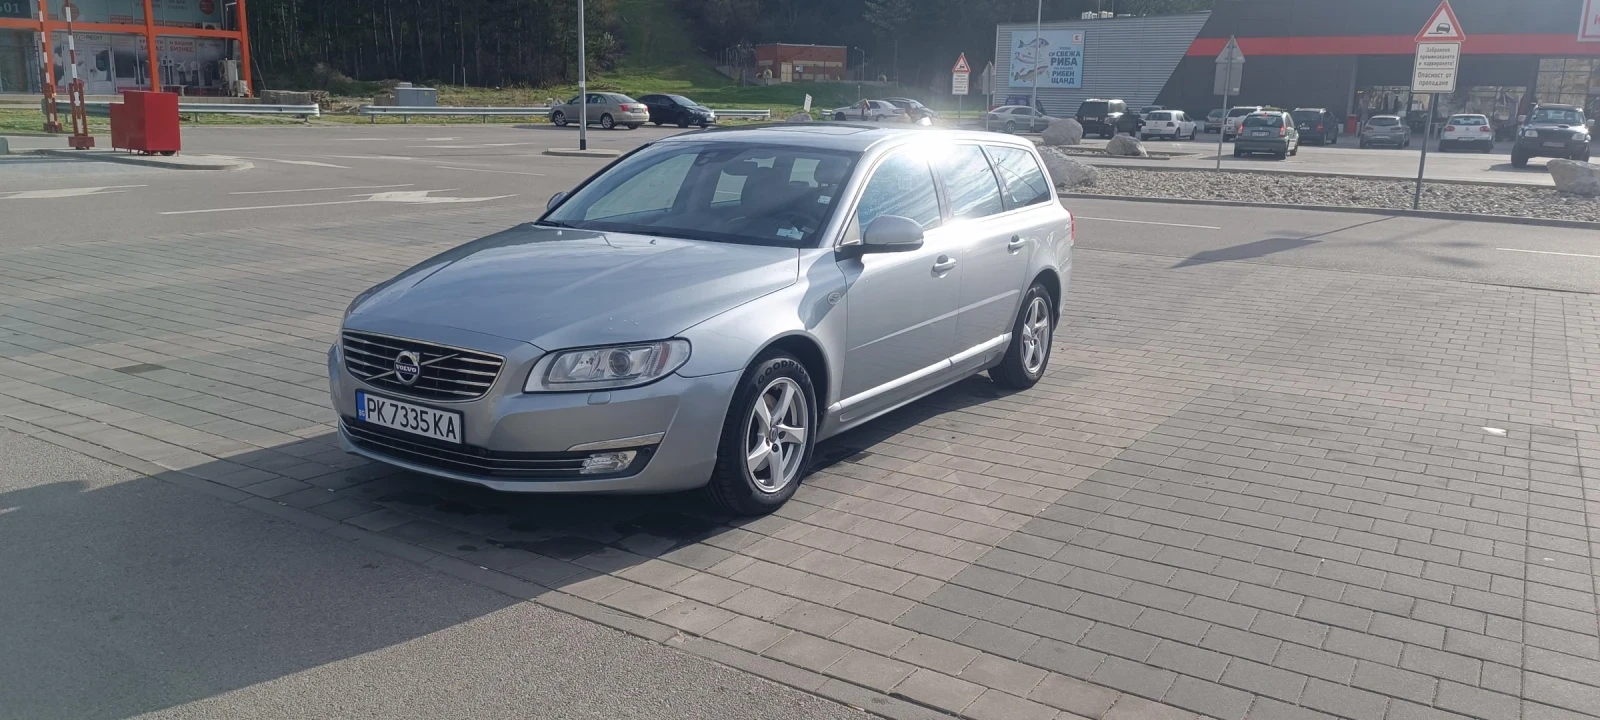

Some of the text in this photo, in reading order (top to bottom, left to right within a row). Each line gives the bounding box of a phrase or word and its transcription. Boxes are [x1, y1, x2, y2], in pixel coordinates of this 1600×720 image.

[1050, 57, 1078, 66] РИБА
[1051, 77, 1075, 85] ЩАНД
[395, 364, 417, 373] VOLVO
[358, 409, 366, 417] BG
[389, 403, 430, 433] 7335
